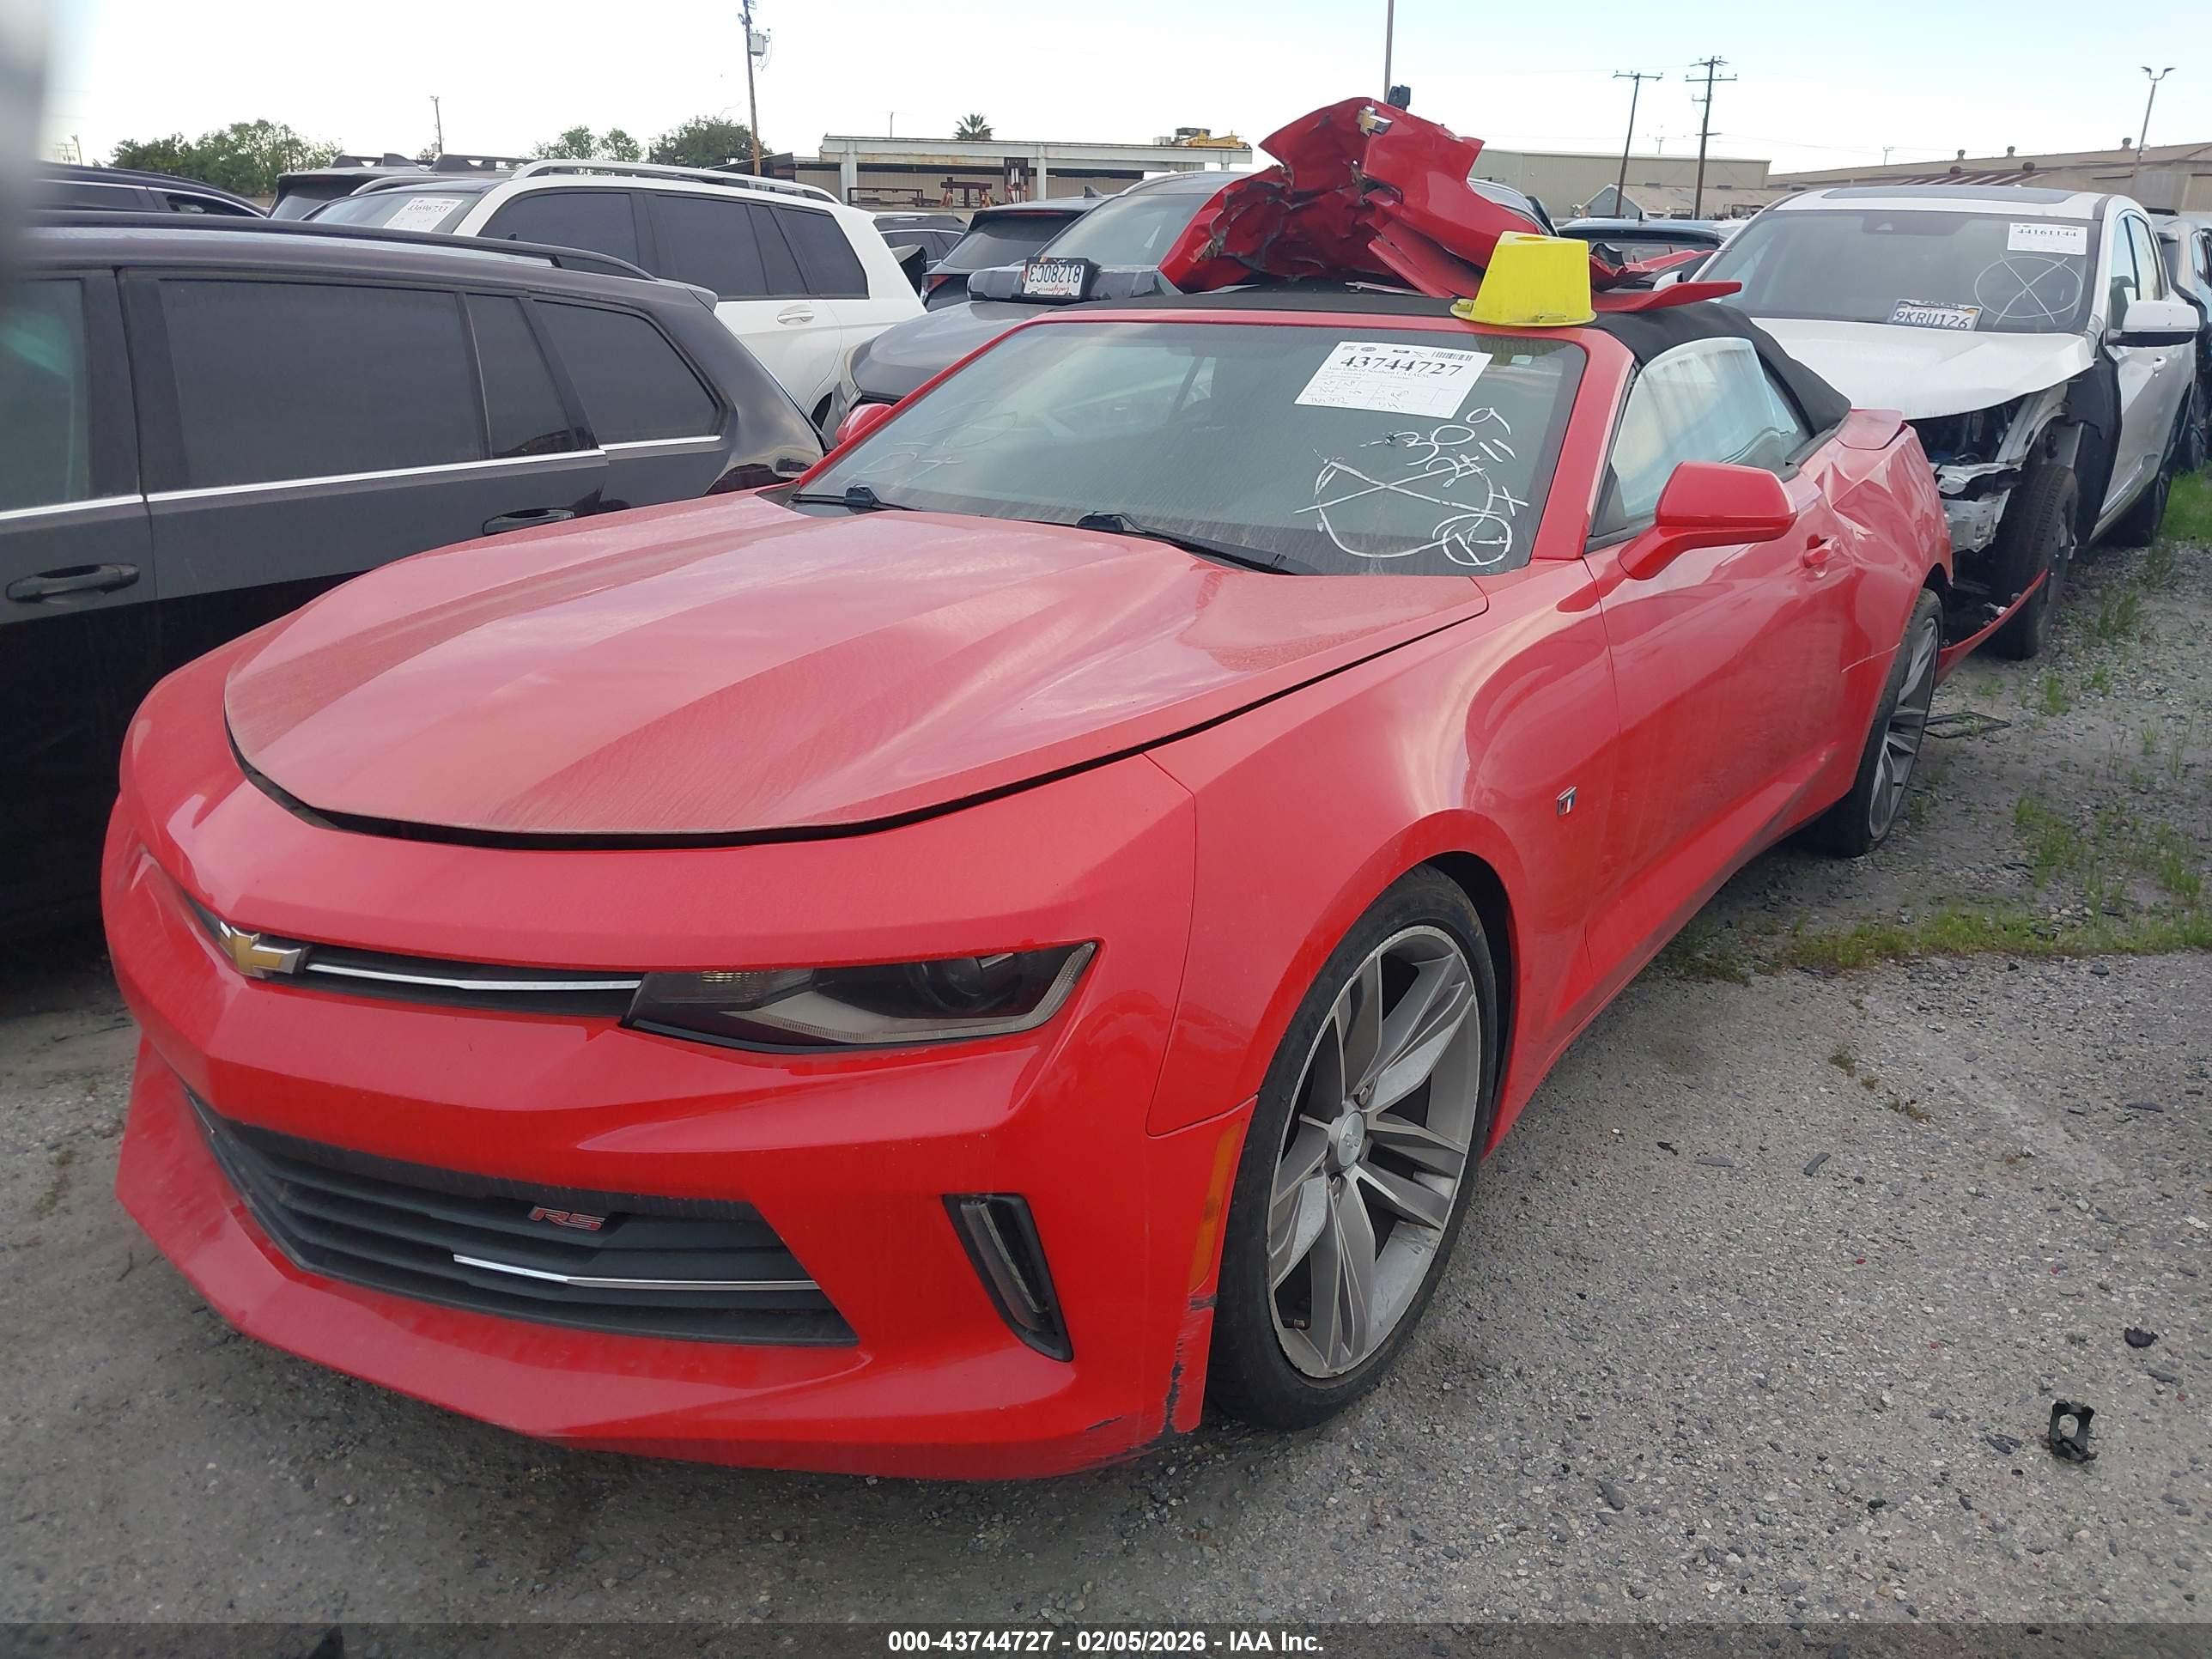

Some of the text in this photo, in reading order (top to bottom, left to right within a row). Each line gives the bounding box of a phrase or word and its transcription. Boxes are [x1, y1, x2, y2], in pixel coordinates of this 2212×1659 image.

[2017, 228, 2077, 237] 44161144
[1030, 264, 1082, 283] 81280C3
[1895, 311, 1972, 330] 9KRU126
[1340, 355, 1464, 377] 43744727
[528, 1206, 605, 1231] RS
